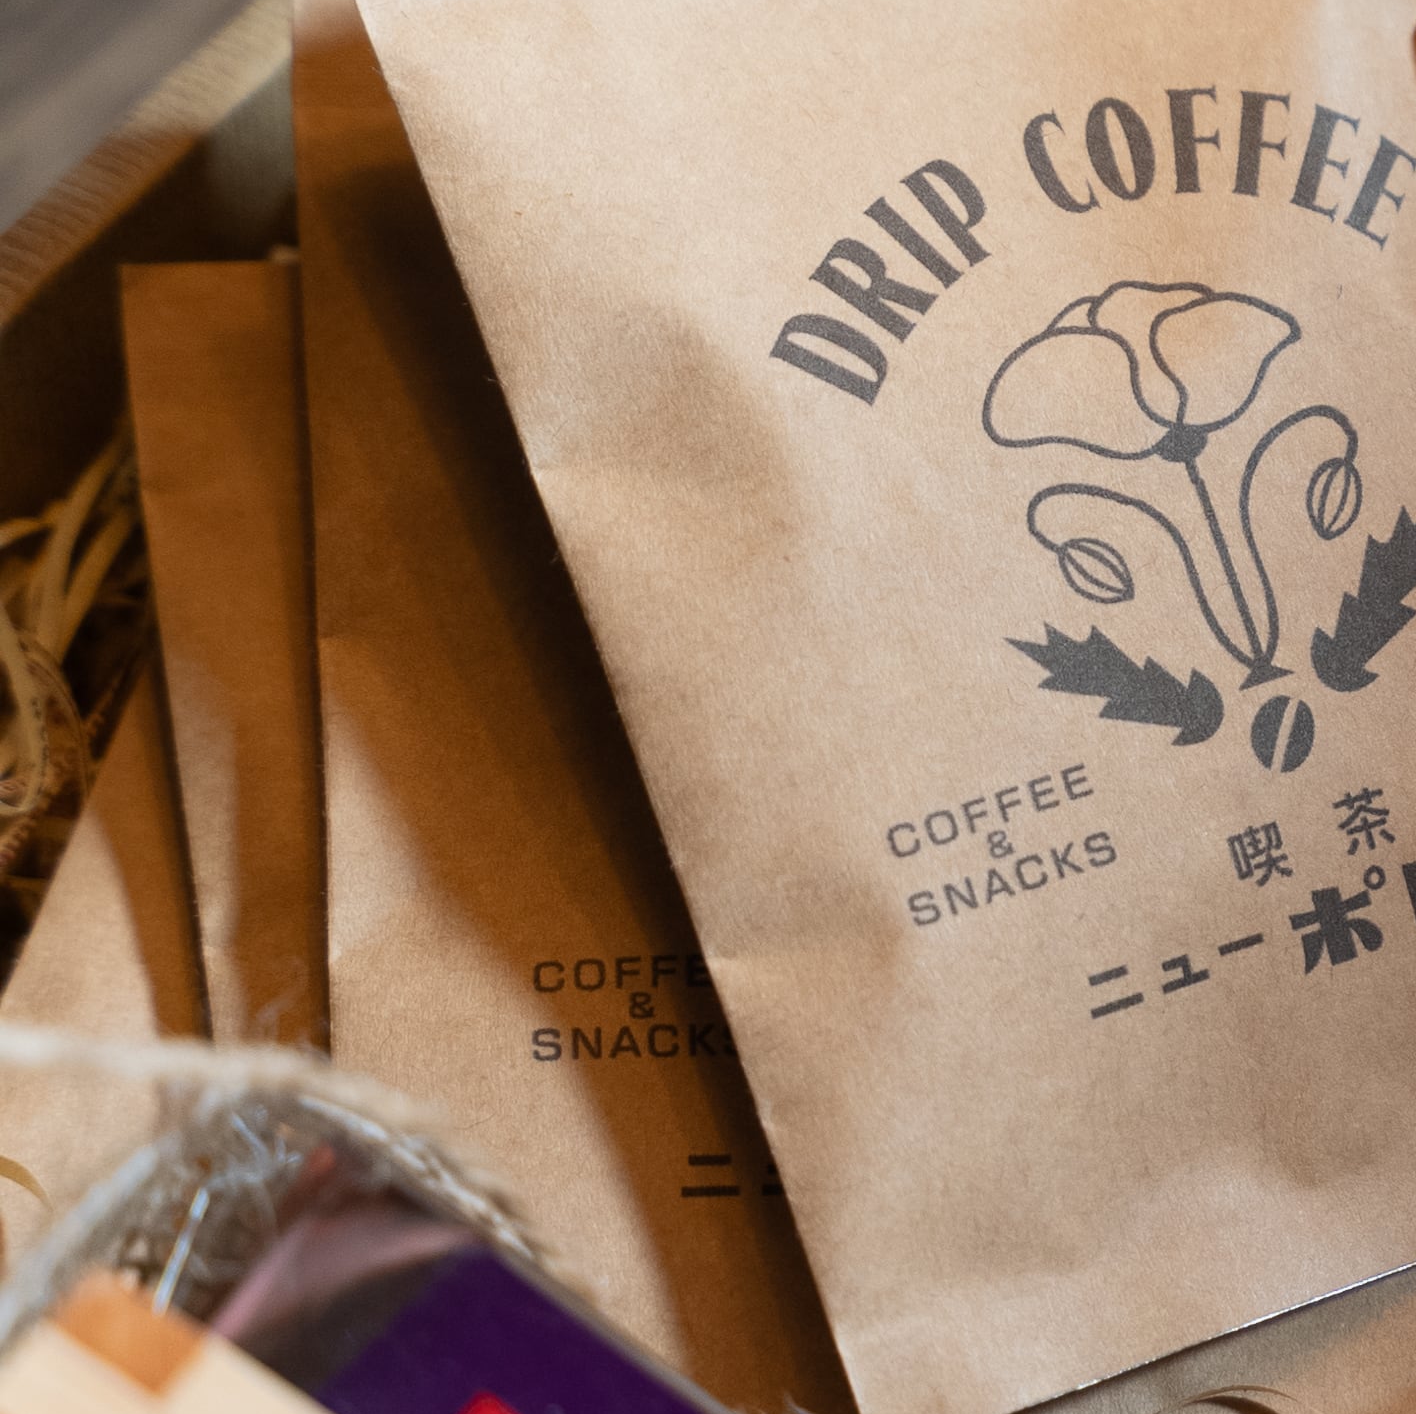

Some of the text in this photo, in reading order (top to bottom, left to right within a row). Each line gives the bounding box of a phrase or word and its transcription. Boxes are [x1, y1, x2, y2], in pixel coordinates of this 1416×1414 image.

[768, 158, 993, 406] DRIP
[886, 762, 1095, 859] COFFEE
[986, 829, 1015, 860] &
[906, 830, 1118, 927] SNACKS
[628, 991, 656, 1020] &
